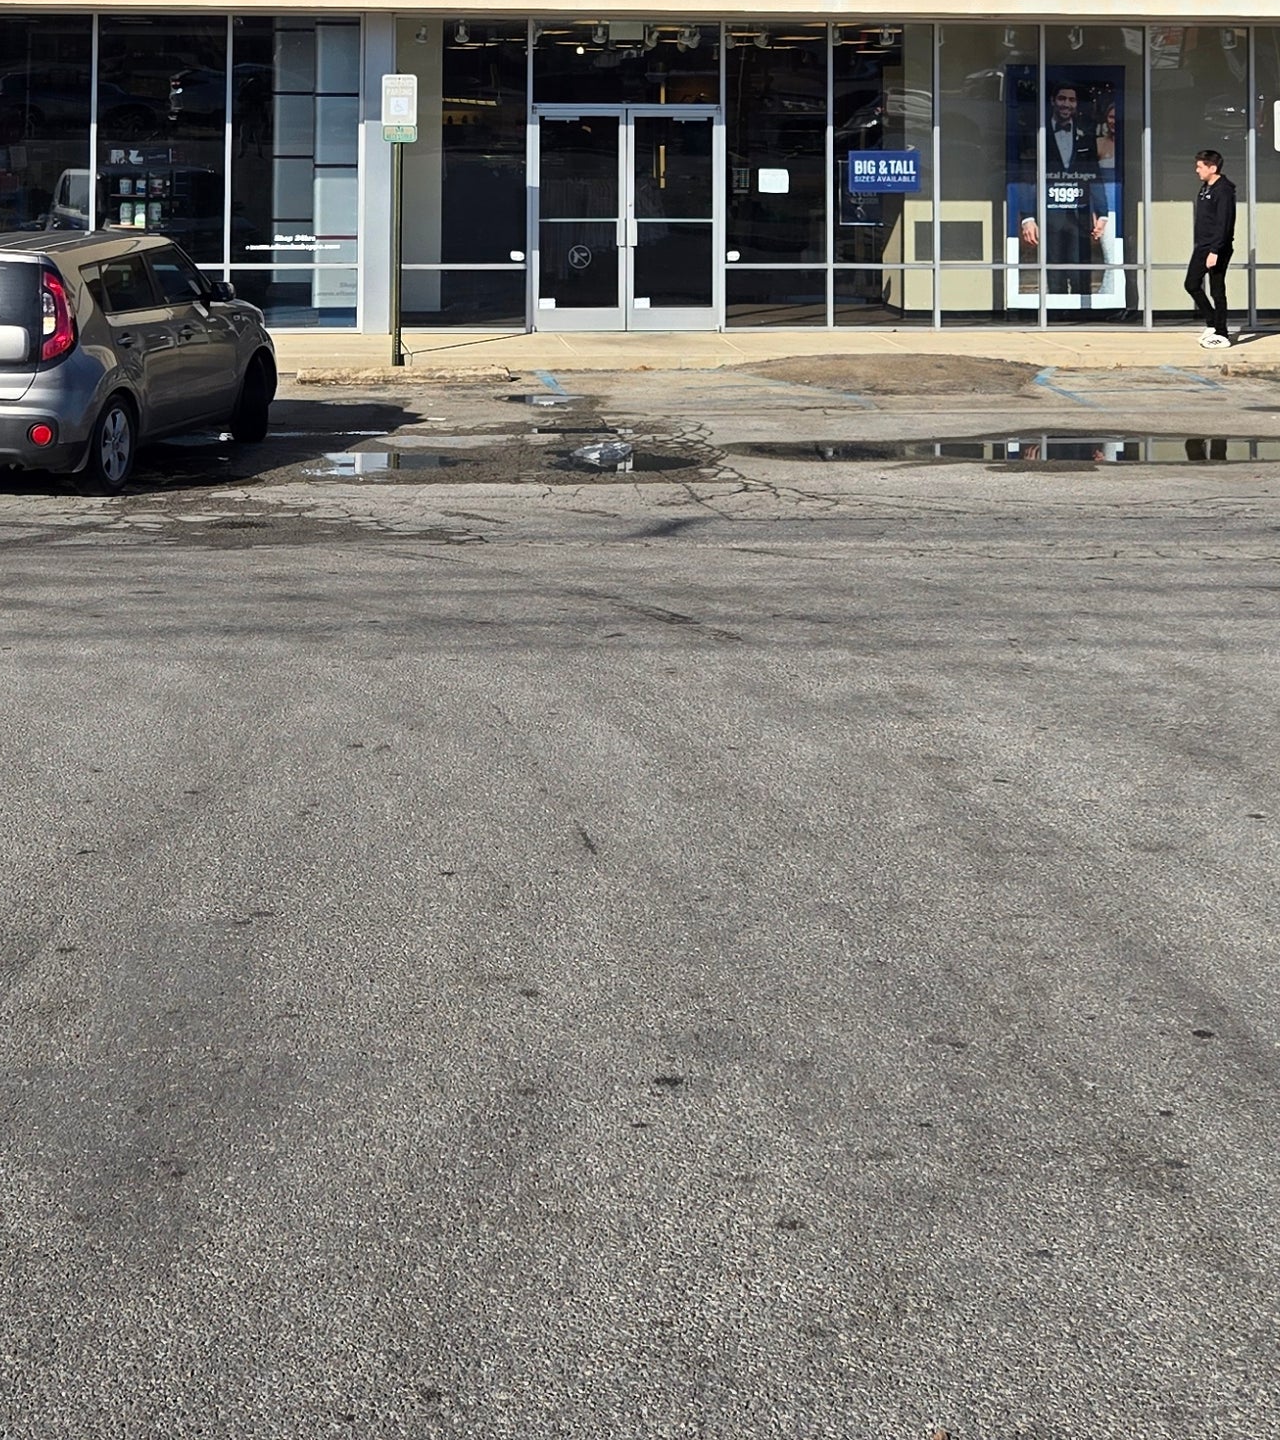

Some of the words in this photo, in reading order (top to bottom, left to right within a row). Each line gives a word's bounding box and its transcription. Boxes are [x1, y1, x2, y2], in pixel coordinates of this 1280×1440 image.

[854, 160, 875, 175] BIG
[878, 160, 889, 175] &
[889, 160, 916, 175] TALL
[1062, 172, 1096, 181] Packages
